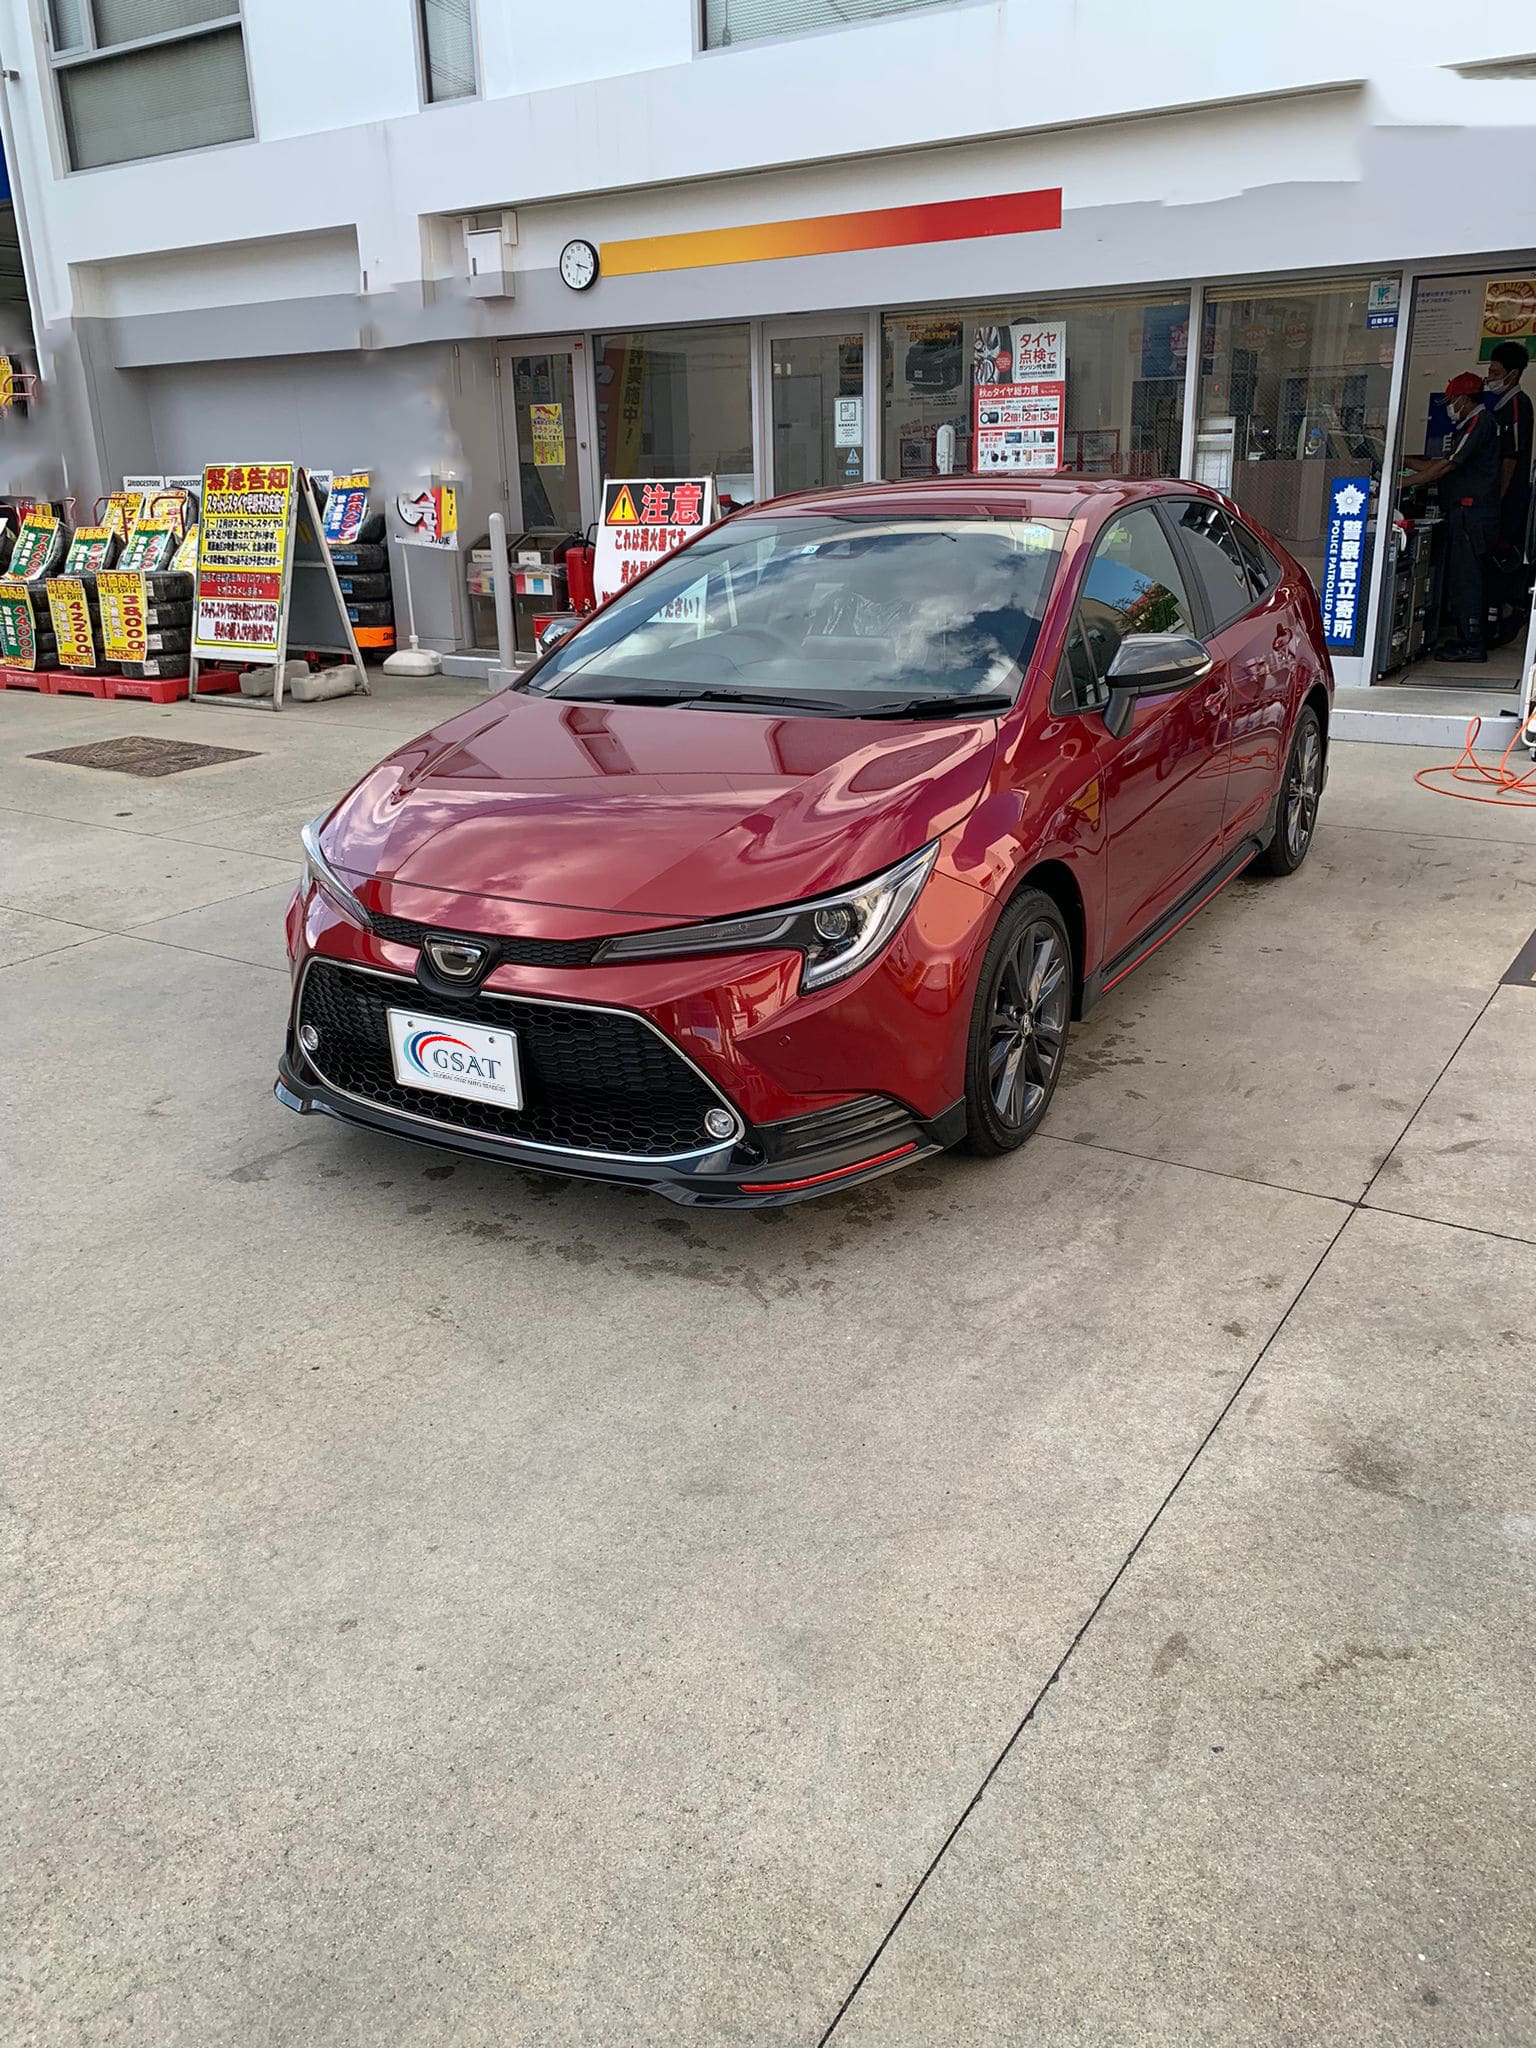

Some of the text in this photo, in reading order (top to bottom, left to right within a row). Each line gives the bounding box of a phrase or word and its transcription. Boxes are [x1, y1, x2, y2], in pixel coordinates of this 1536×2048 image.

[1020, 332, 1057, 348] タイヤ
[1019, 348, 1057, 364] 点検で
[207, 467, 288, 491] 緊急告知
[641, 483, 702, 524] 注意
[615, 527, 687, 551] これは消火器です
[1329, 520, 1340, 554] POLICE
[47, 580, 82, 594] 特価商品
[97, 573, 141, 588] 特価商品
[1324, 558, 1337, 611] PATROLLED
[1333, 520, 1363, 639] 警察官立寄所
[433, 1048, 502, 1080] GSAT
